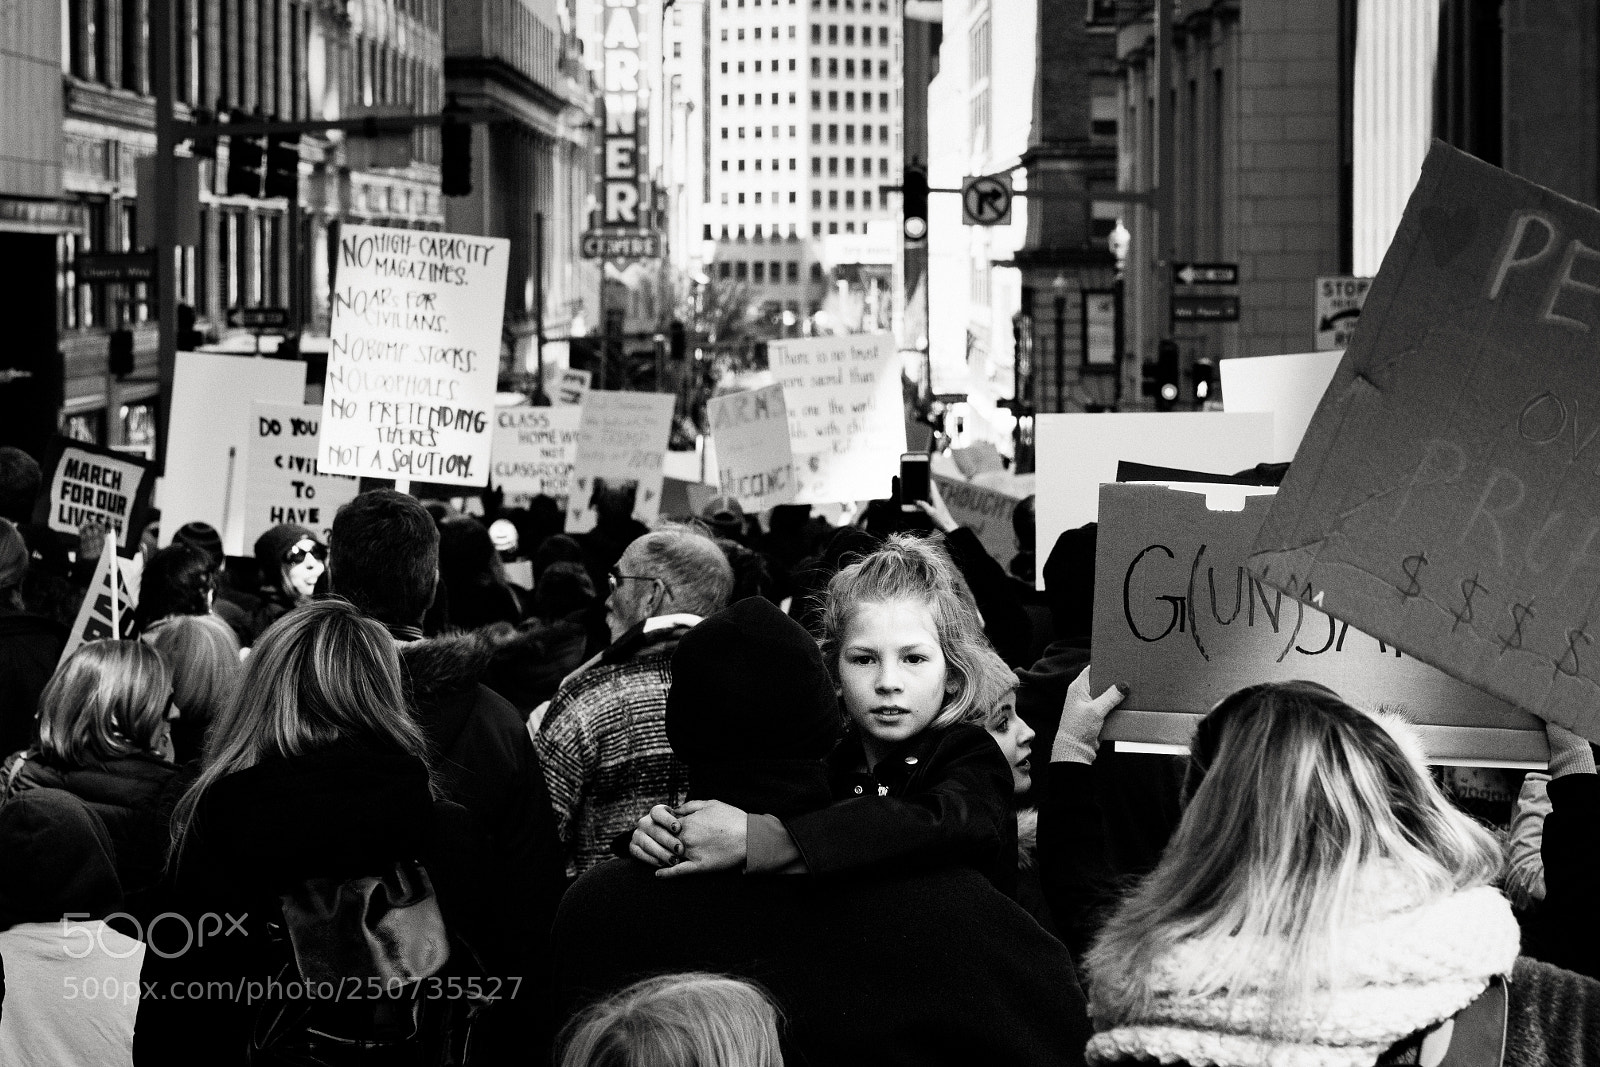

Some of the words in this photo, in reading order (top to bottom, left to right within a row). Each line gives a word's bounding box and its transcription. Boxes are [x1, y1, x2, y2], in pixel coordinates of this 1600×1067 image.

[603, 0, 640, 223] ARNER
[342, 235, 373, 268] NO
[335, 287, 368, 317] NO
[406, 292, 437, 311] FOR
[1323, 280, 1369, 297] STOP
[332, 333, 364, 362] NO
[367, 339, 409, 362] BUMP
[329, 365, 361, 393] NO
[259, 416, 281, 437] DO
[290, 417, 318, 437] YOU
[330, 398, 357, 419] NO
[369, 400, 488, 433] PRETENDING
[498, 411, 549, 428] CLASS
[328, 446, 362, 469] NOT
[371, 450, 382, 469] A
[63, 457, 122, 491] MARCH
[60, 480, 94, 507] FOR
[96, 490, 128, 516] OUR
[291, 481, 316, 498] TO
[271, 506, 320, 524] HAVE
